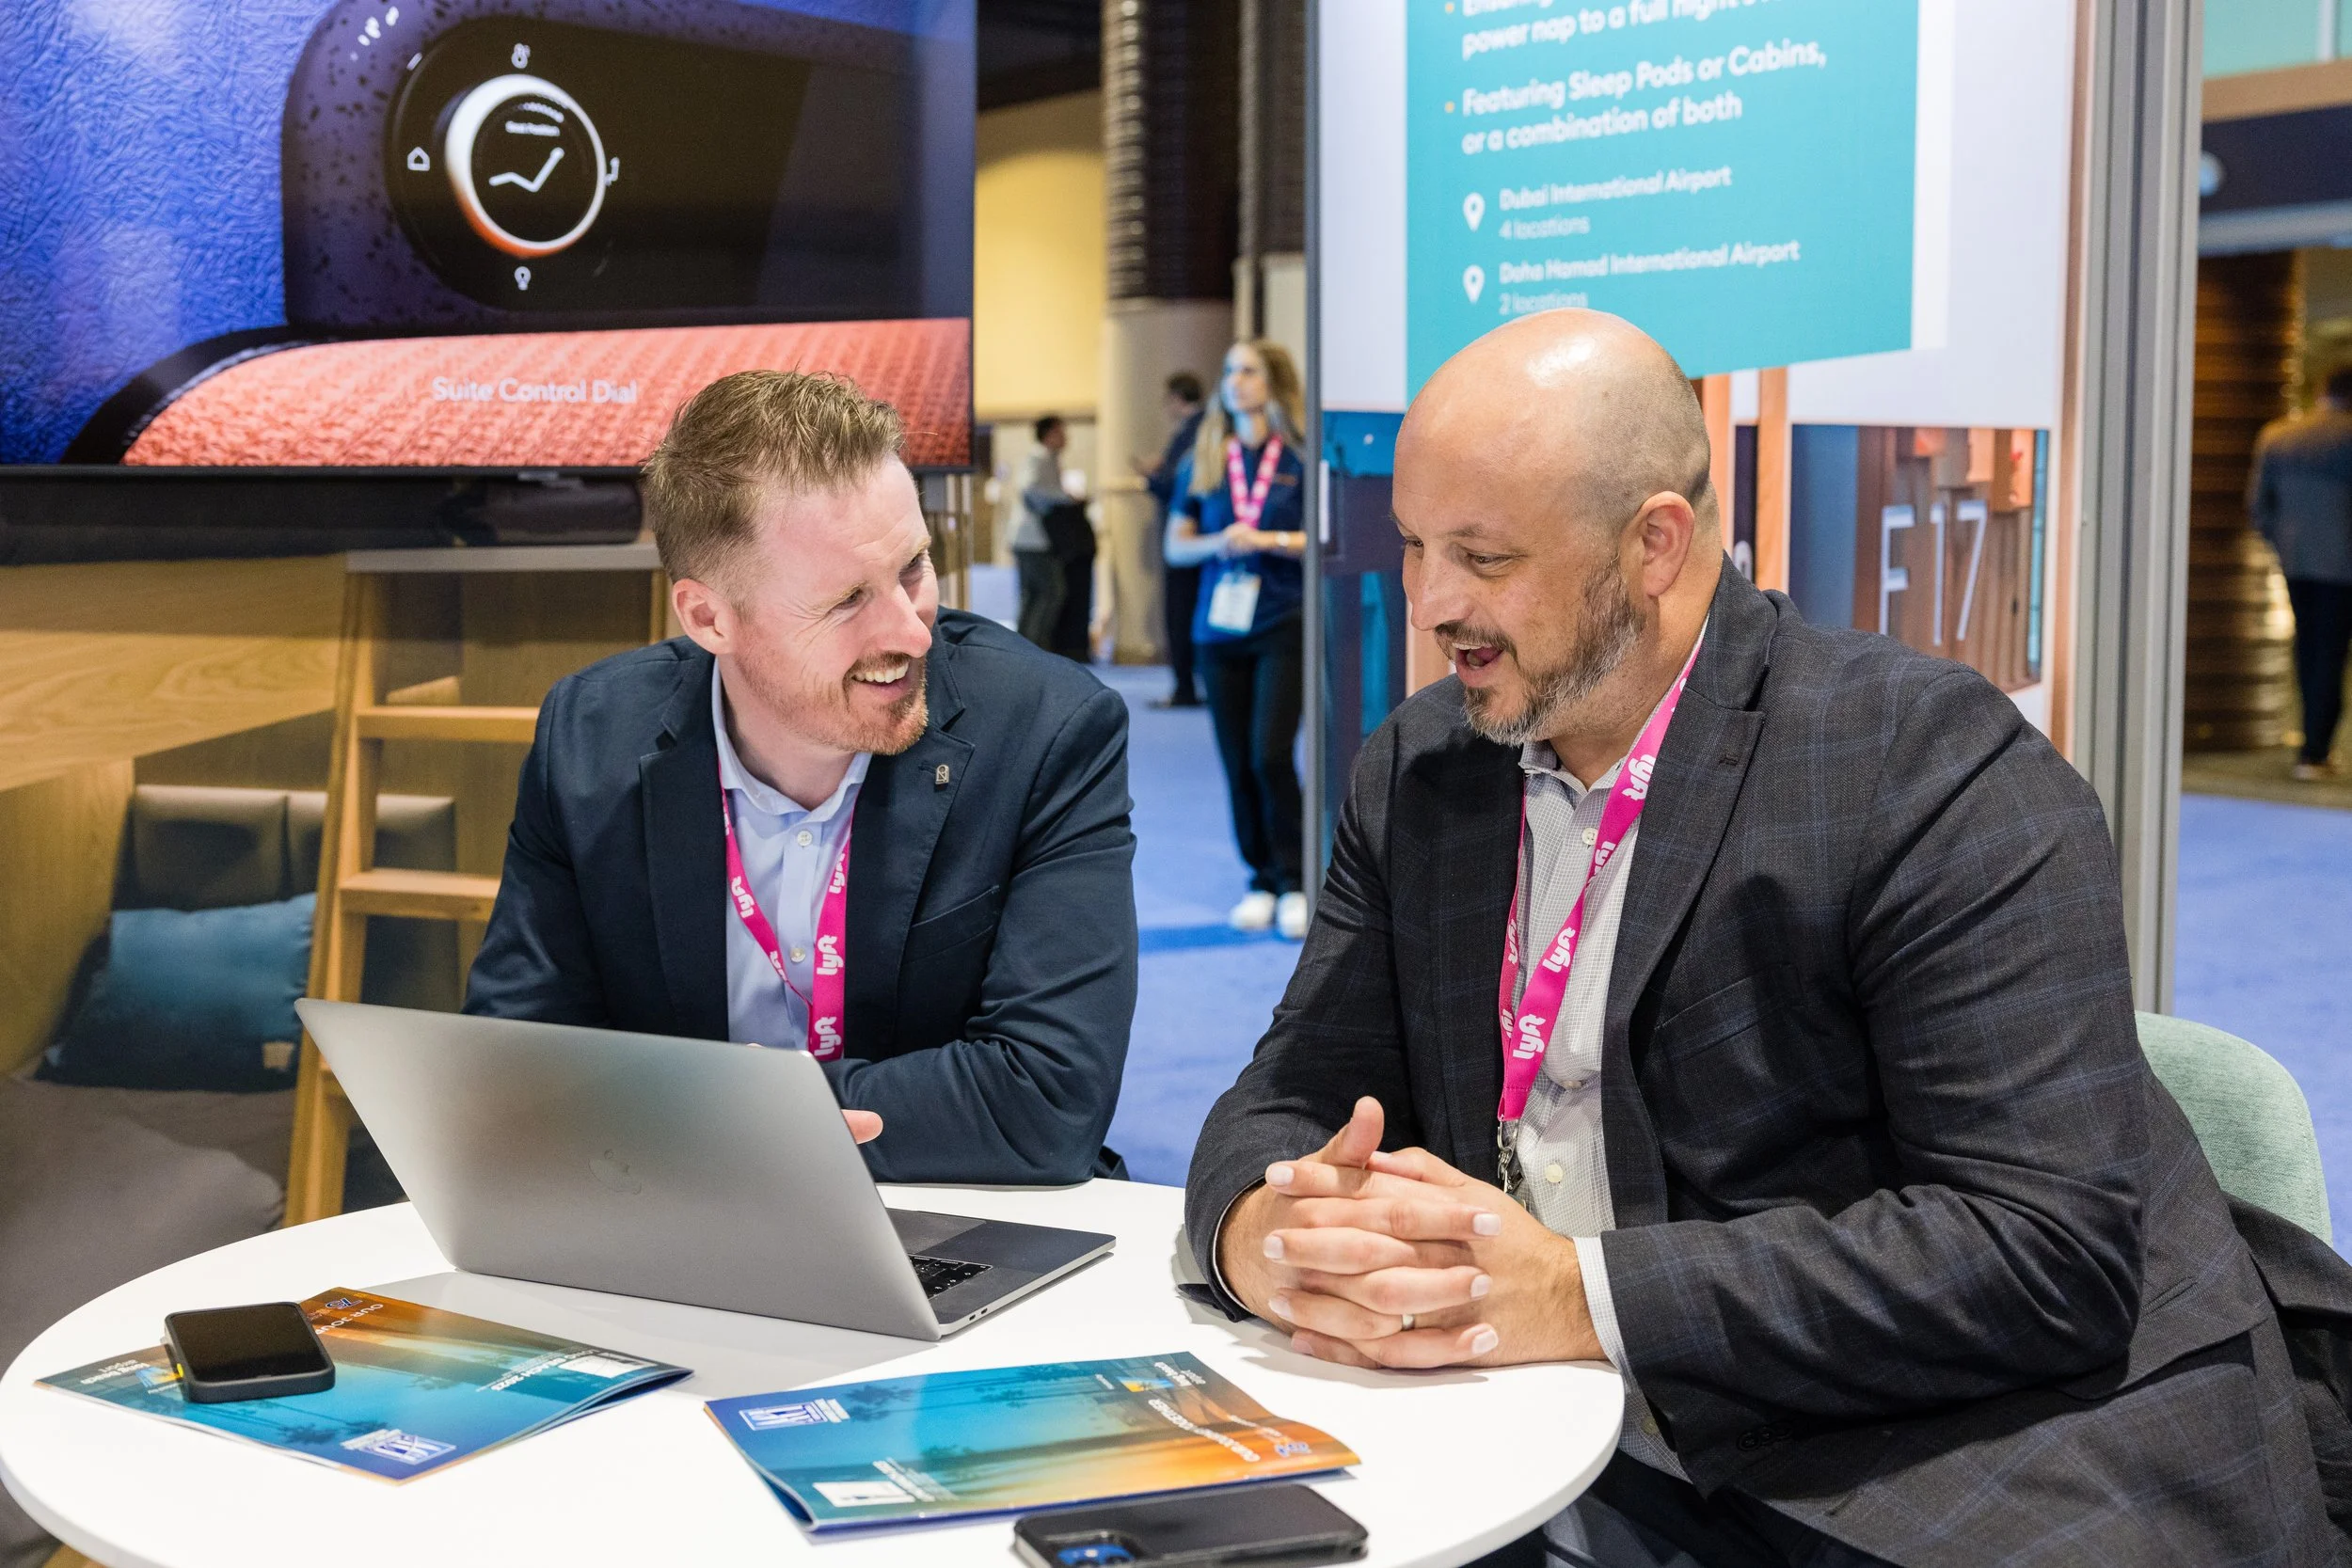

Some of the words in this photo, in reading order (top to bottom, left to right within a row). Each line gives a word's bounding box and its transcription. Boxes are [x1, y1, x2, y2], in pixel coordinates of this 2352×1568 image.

[1462, 23, 1530, 61] power
[1532, 15, 1577, 43] nap
[1579, 8, 1605, 34] to
[1608, 7, 1626, 29] a
[1629, 0, 1668, 25] full
[1463, 77, 1565, 117] Featuring
[1568, 70, 1632, 101] Sleep
[1635, 55, 1694, 90] Pods
[1697, 56, 1725, 81] or
[1727, 37, 1826, 75] Cabins,
[1462, 132, 1486, 154] or
[1487, 129, 1503, 151] a
[1506, 105, 1648, 149] combination
[1651, 97, 1680, 130] of
[1682, 89, 1742, 125] both
[1499, 186, 1549, 211] Dubai
[1550, 169, 1663, 204] International
[1664, 166, 1732, 194] Airport
[1499, 219, 1512, 240] 4
[1513, 214, 1590, 240] locations
[1499, 261, 1544, 284] Doha
[1545, 255, 1608, 279] Hamad
[1610, 244, 1728, 275] International
[1729, 240, 1800, 268] Airport
[1499, 293, 1512, 315] 2
[432, 376, 493, 402] Suite
[499, 377, 587, 403] Control
[592, 378, 637, 404] Dial
[731, 876, 755, 918] lyft
[817, 935, 844, 975] lyft
[1542, 927, 1576, 973] lyft
[814, 1016, 842, 1056] lyft
[1513, 1013, 1547, 1060] lyft
[350, 1304, 384, 1318] OUR
